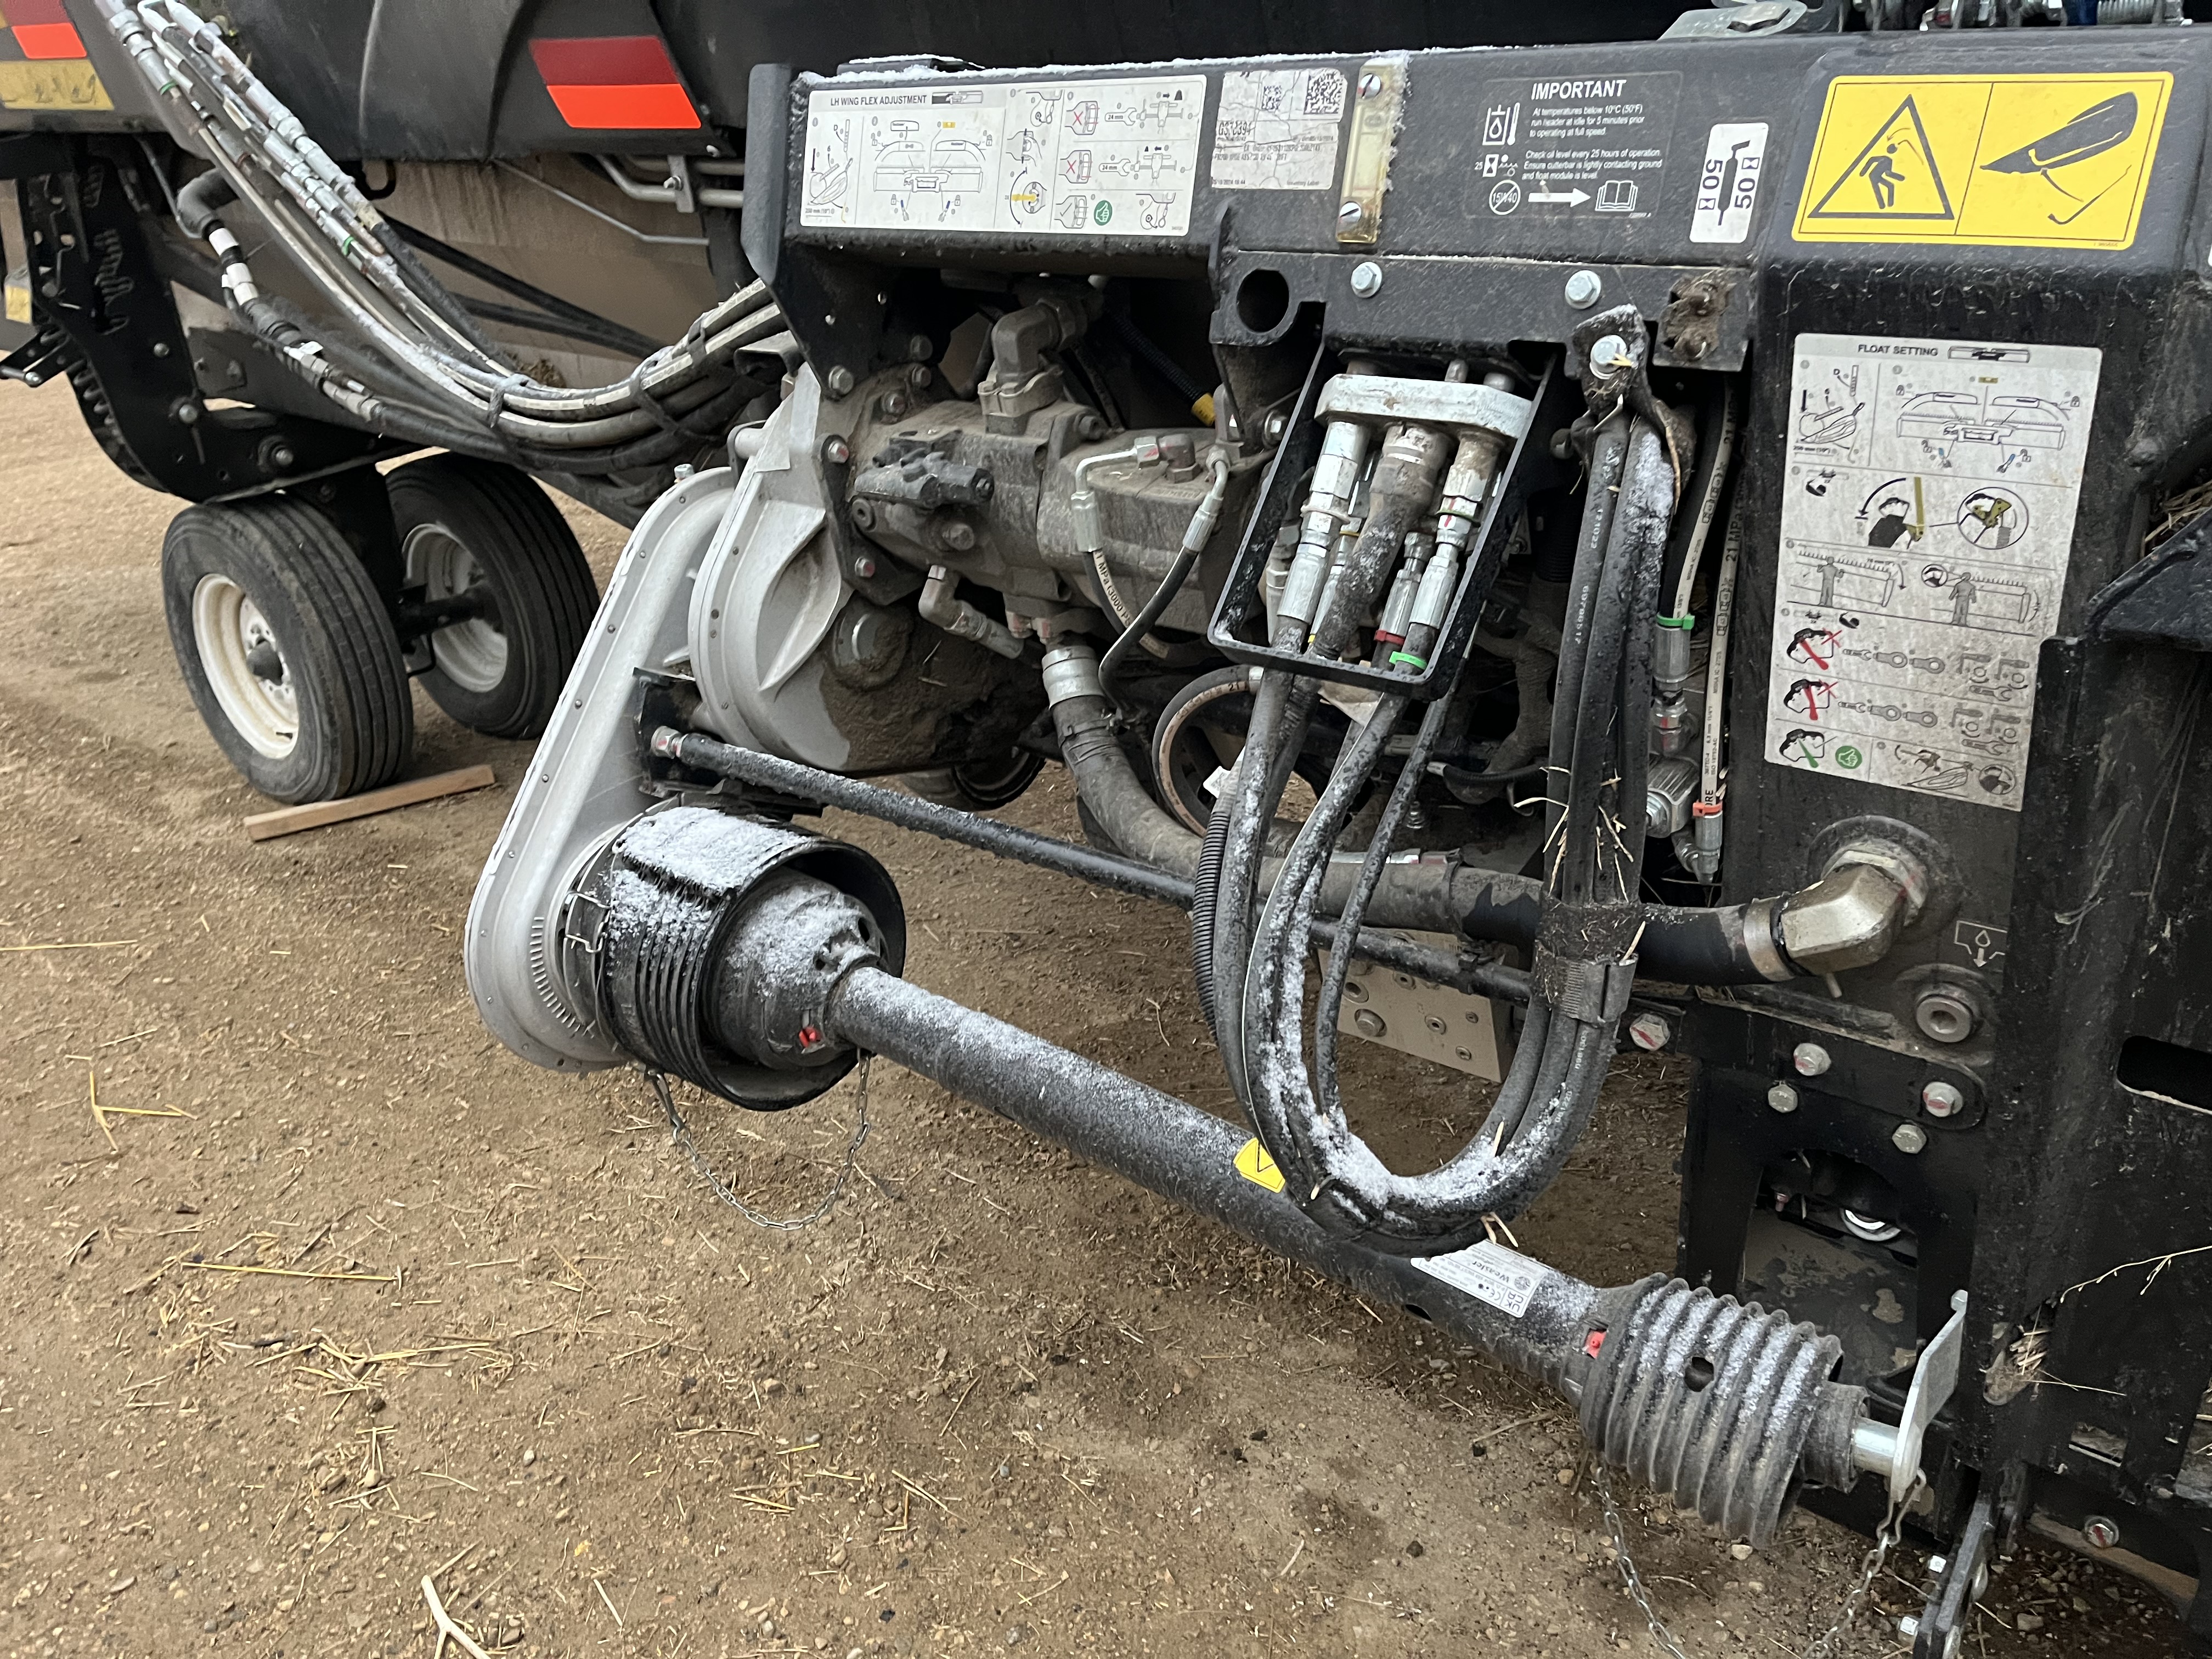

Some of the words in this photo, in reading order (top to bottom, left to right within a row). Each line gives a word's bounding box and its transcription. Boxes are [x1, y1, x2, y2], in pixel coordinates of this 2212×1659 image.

[1531, 80, 1627, 100] IMPORTANT
[830, 97, 839, 106] LH
[840, 96, 859, 105] WING
[860, 95, 878, 105] FLEX
[879, 94, 927, 104] ADJUSTMENT
[1532, 108, 1541, 116] At
[1542, 107, 1583, 117] temperatures
[1583, 106, 1603, 114] below
[1605, 104, 1621, 114] 10°C
[1542, 117, 1566, 126] header
[1566, 117, 1573, 126] at
[1573, 116, 1585, 125] idle
[1586, 116, 1596, 125] for
[1596, 116, 1602, 125] 5
[1602, 116, 1628, 125] minutes
[1628, 116, 1645, 126] prior
[1530, 129, 1536, 137] to
[1537, 128, 1566, 138] operating
[1566, 128, 1574, 136] at
[1574, 127, 1585, 136] full
[1526, 150, 1546, 159] Check
[1546, 150, 1555, 158] oil
[1555, 149, 1572, 158] level
[1572, 149, 1590, 160] every
[1590, 149, 1600, 157] 25
[1600, 149, 1620, 158] hours
[1621, 148, 1629, 157] of
[1474, 161, 1483, 170] 25
[1524, 160, 1546, 170] Ensure
[1547, 160, 1576, 169] cutterbar
[1576, 160, 1582, 168] is
[1583, 160, 1603, 171] lightly
[1603, 159, 1637, 171] contacting
[1638, 159, 1663, 170] ground
[1522, 171, 1534, 180] and
[1535, 171, 1549, 180] float
[1550, 171, 1574, 179] module
[1702, 159, 1723, 190] 50
[1734, 178, 1756, 209] 50
[1858, 344, 1891, 354] FLOAT
[1893, 346, 1938, 356] SETTING
[1728, 513, 1743, 542] MPa
[1725, 548, 1740, 562] 21
[1098, 561, 1110, 585] MPa
[1107, 584, 1123, 612] (3000
[1228, 682, 1240, 692] 21
[1472, 1261, 1509, 1283] Weasler
[1504, 1298, 1521, 1312] UK
